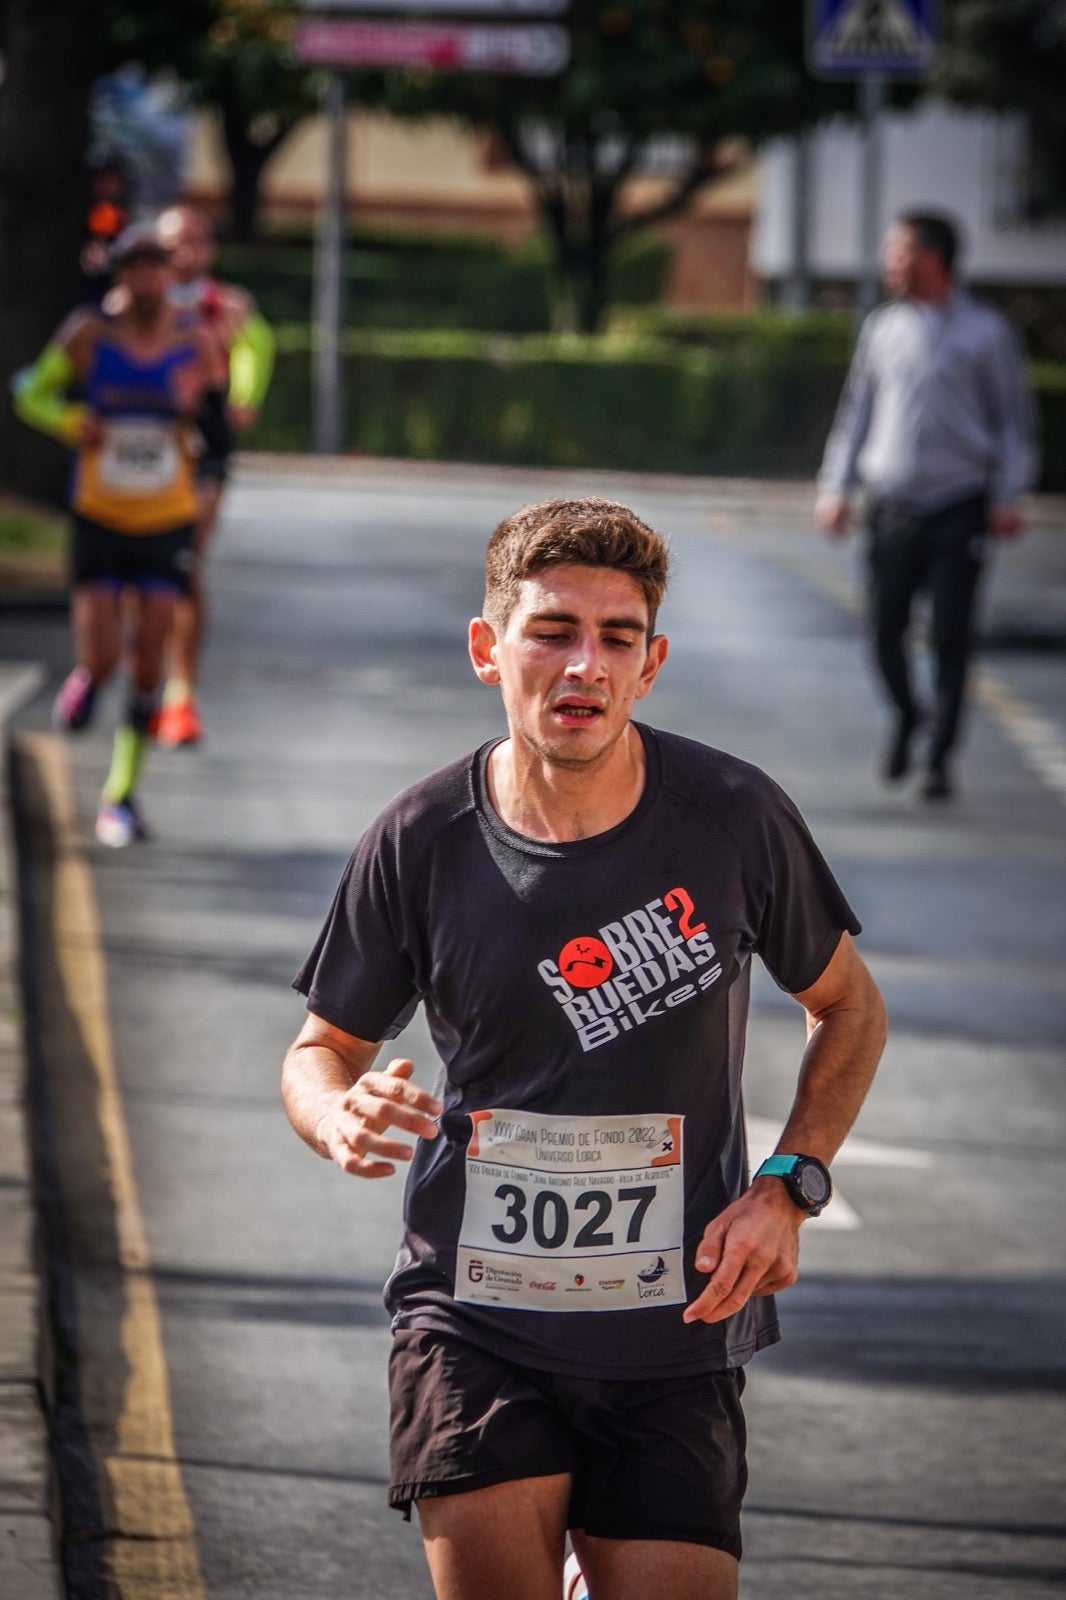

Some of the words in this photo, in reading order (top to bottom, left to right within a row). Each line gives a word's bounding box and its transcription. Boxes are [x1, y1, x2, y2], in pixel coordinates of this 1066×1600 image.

[561, 931, 717, 1030] RUEDAS
[576, 962, 724, 1053] Bikes
[515, 1124, 538, 1144] GRAN
[541, 1128, 575, 1147] PREMIO
[578, 1132, 590, 1146] DE
[594, 1129, 625, 1145] FONDO
[628, 1126, 656, 1144] 2022
[535, 1146, 574, 1163] UNIVERSO
[576, 1149, 602, 1163] LORCA
[490, 1183, 657, 1250] 3027
